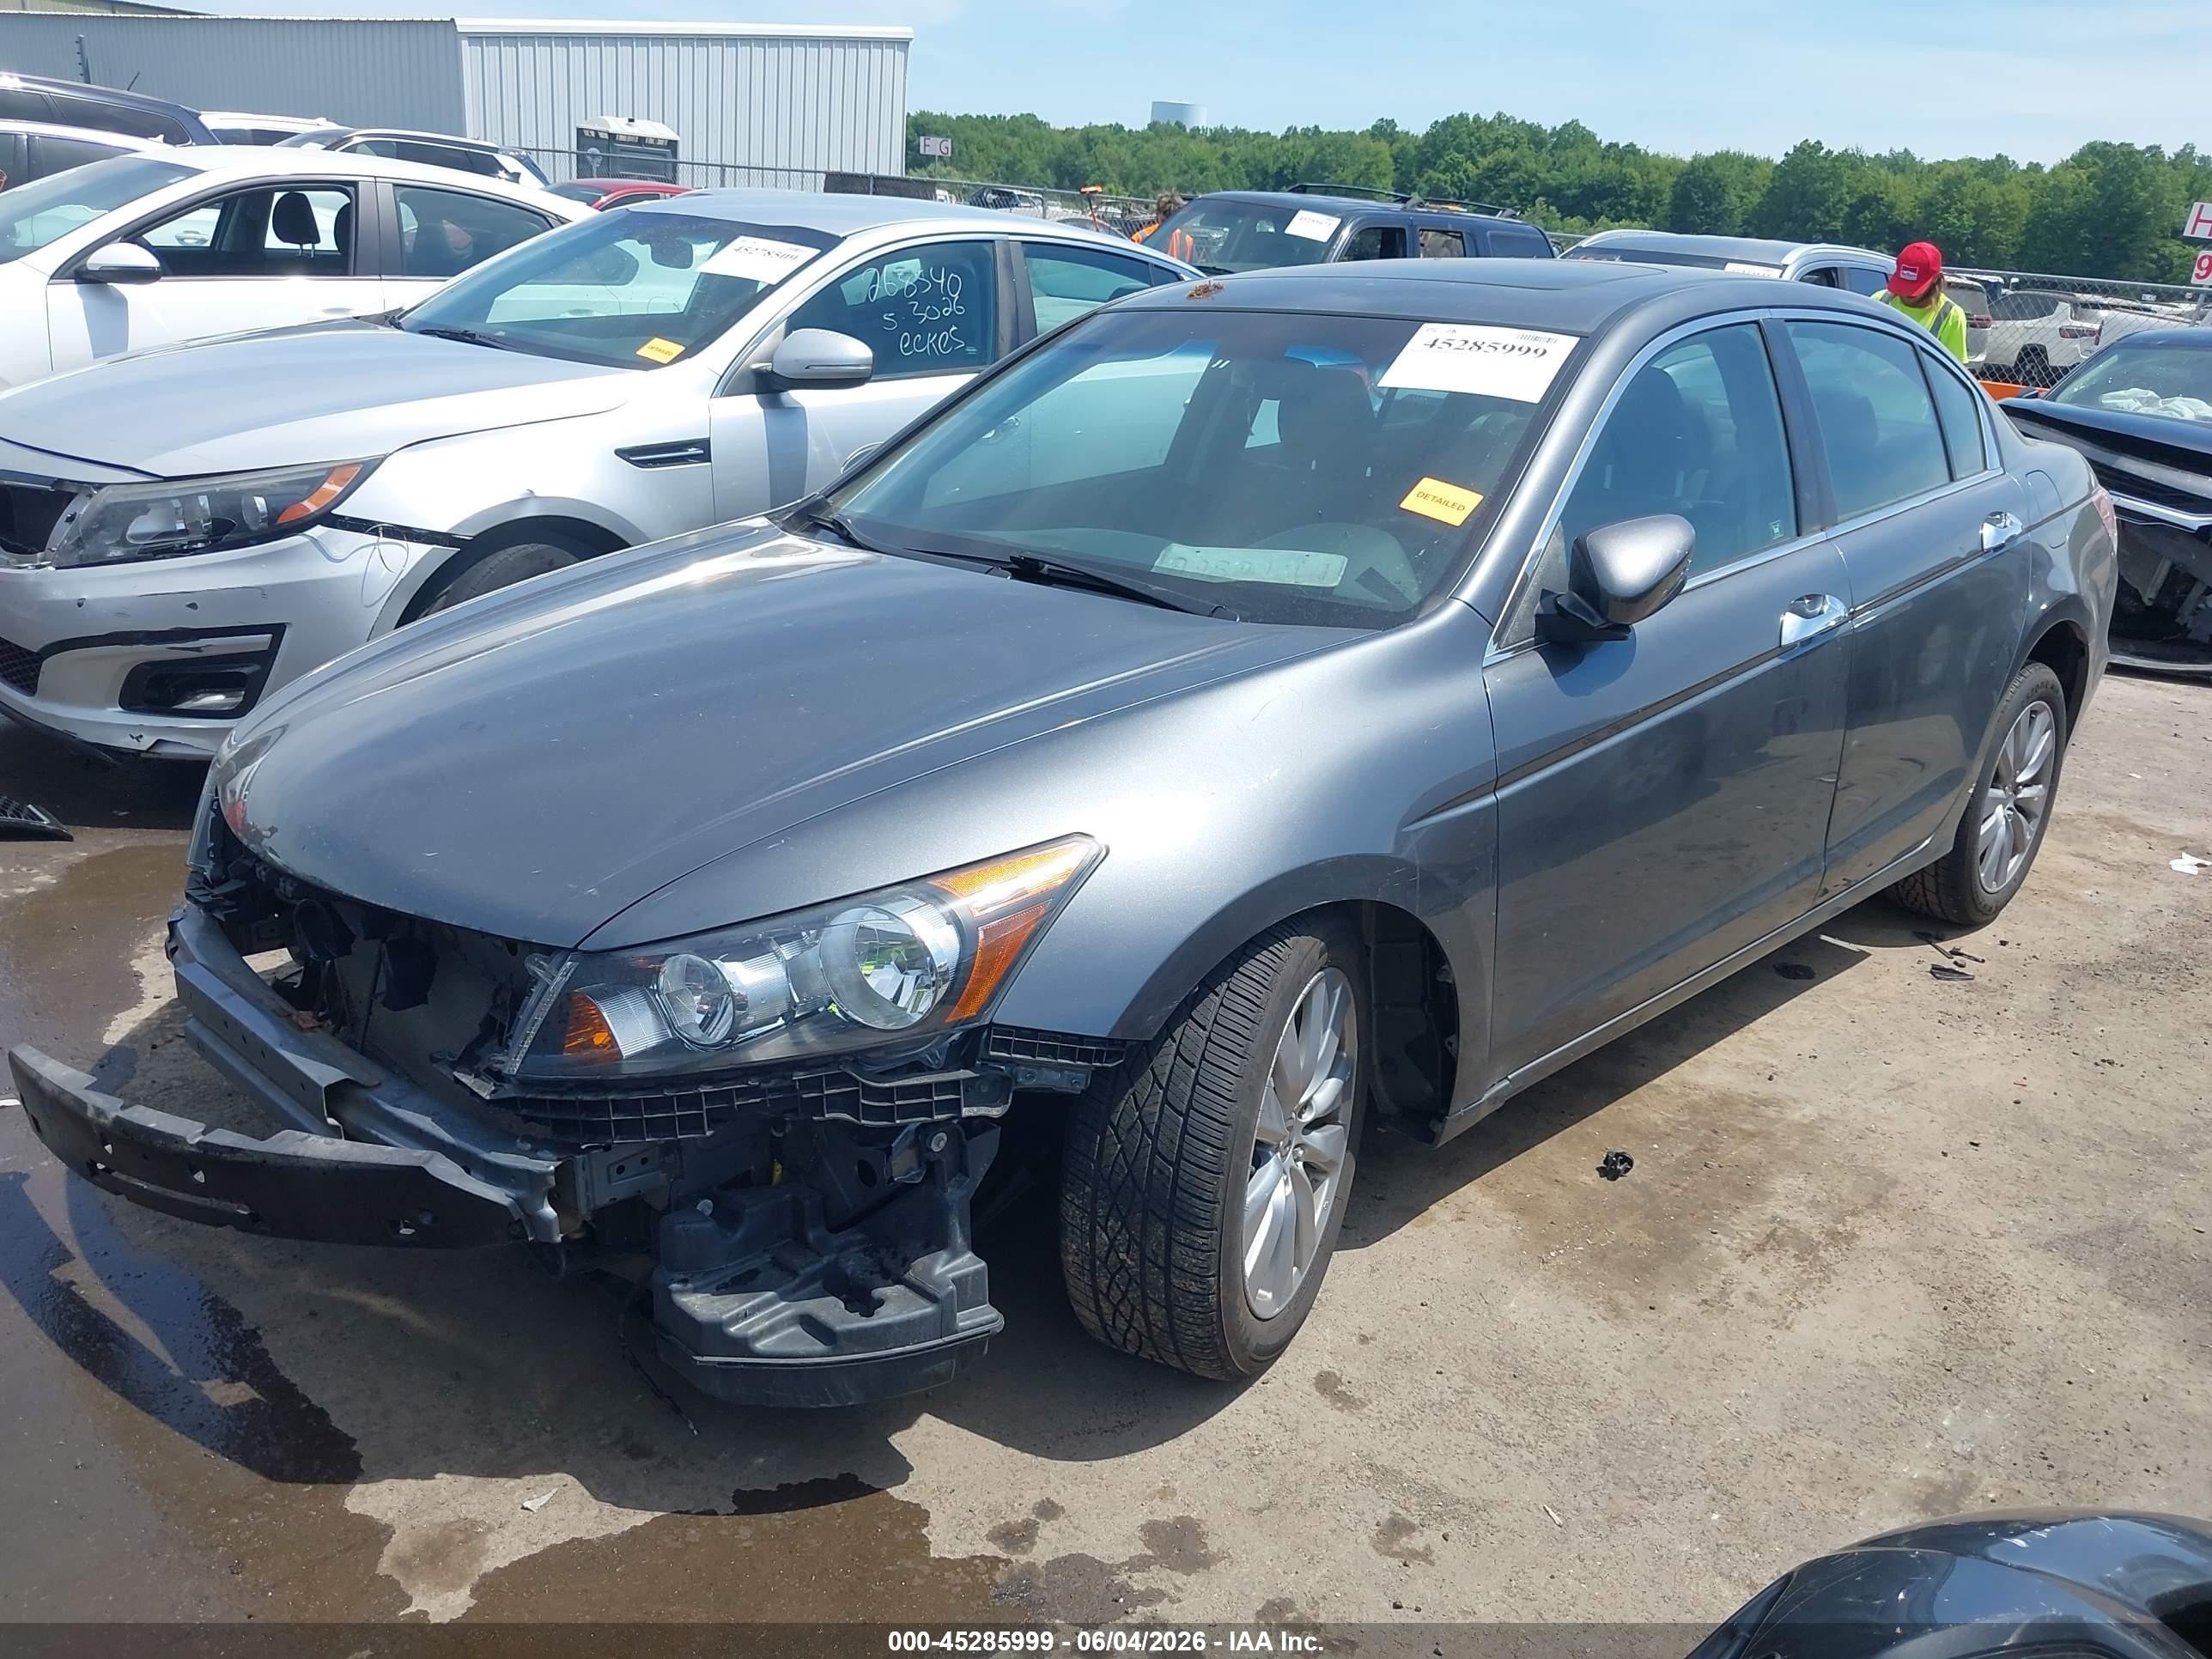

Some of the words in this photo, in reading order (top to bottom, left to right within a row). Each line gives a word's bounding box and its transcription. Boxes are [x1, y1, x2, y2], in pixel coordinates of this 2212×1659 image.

[923, 137, 931, 154] F
[939, 139, 949, 155] G
[2191, 204, 2212, 237] H
[2195, 255, 2212, 280] 9
[1424, 337, 1547, 359] 45285999
[1416, 491, 1466, 512] DETAILED
